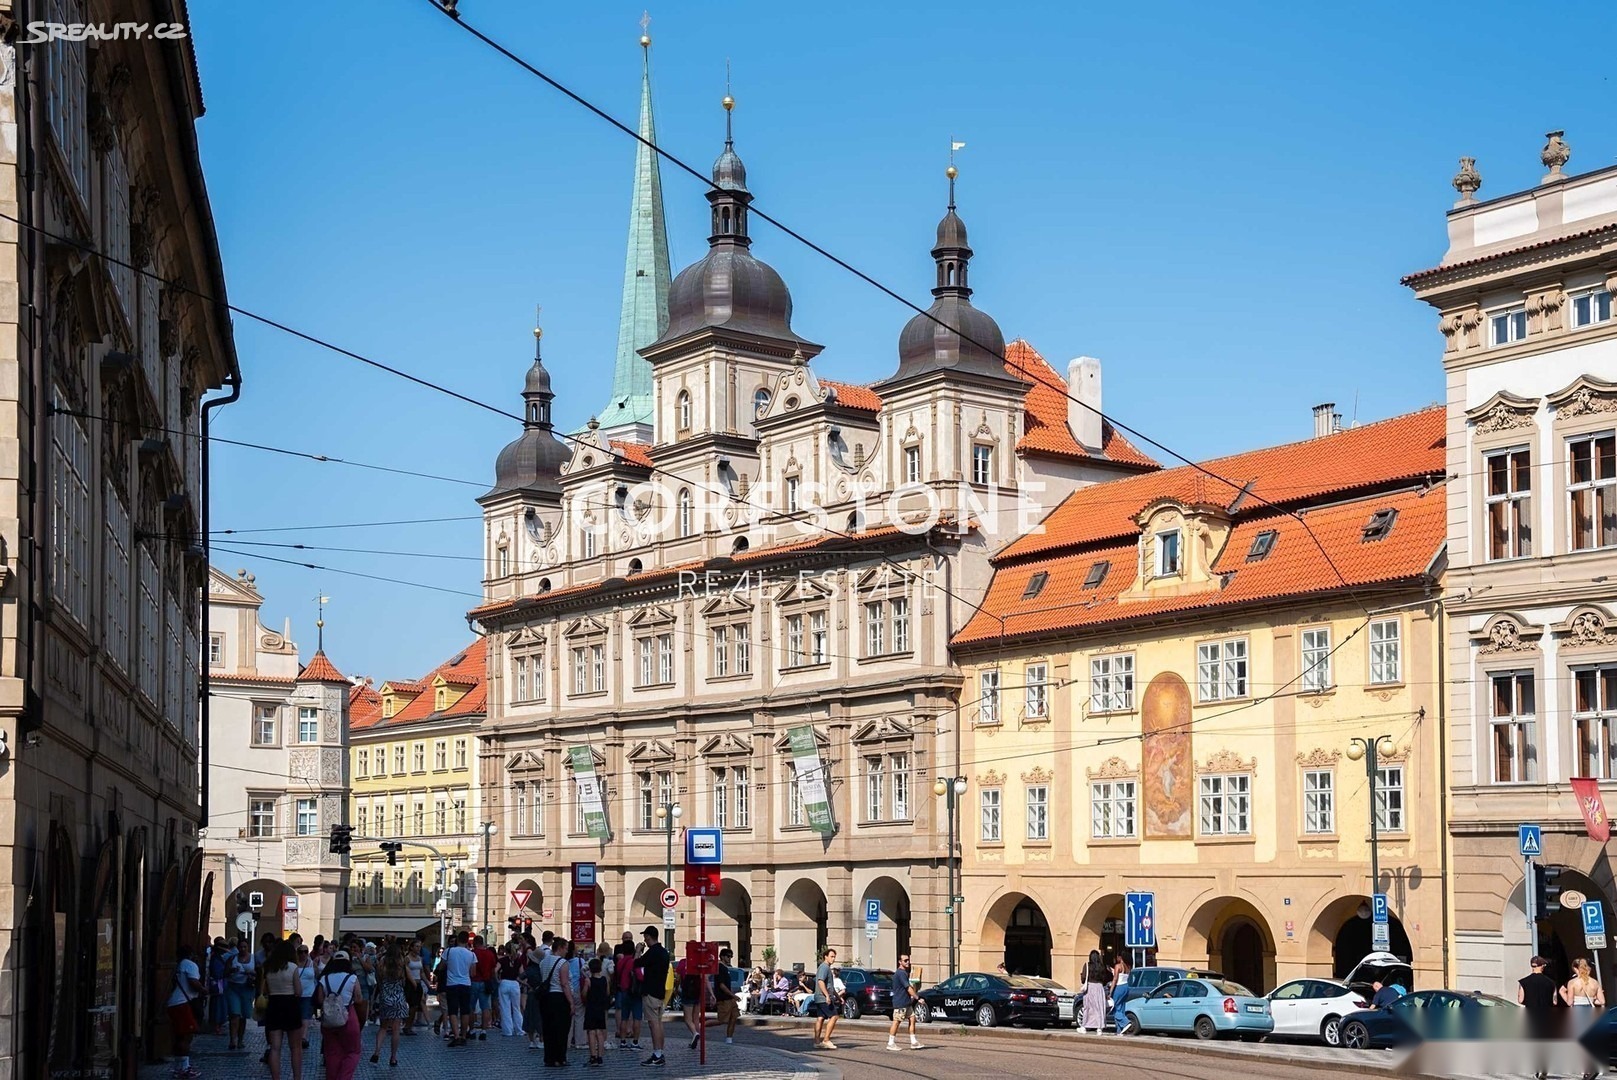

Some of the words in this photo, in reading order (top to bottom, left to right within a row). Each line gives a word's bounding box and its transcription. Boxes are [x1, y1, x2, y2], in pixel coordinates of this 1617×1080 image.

[869, 902, 878, 916] P
[1376, 897, 1385, 914] P
[1586, 905, 1598, 924] P
[944, 998, 957, 1007] Uber
[957, 998, 975, 1007] Airport
